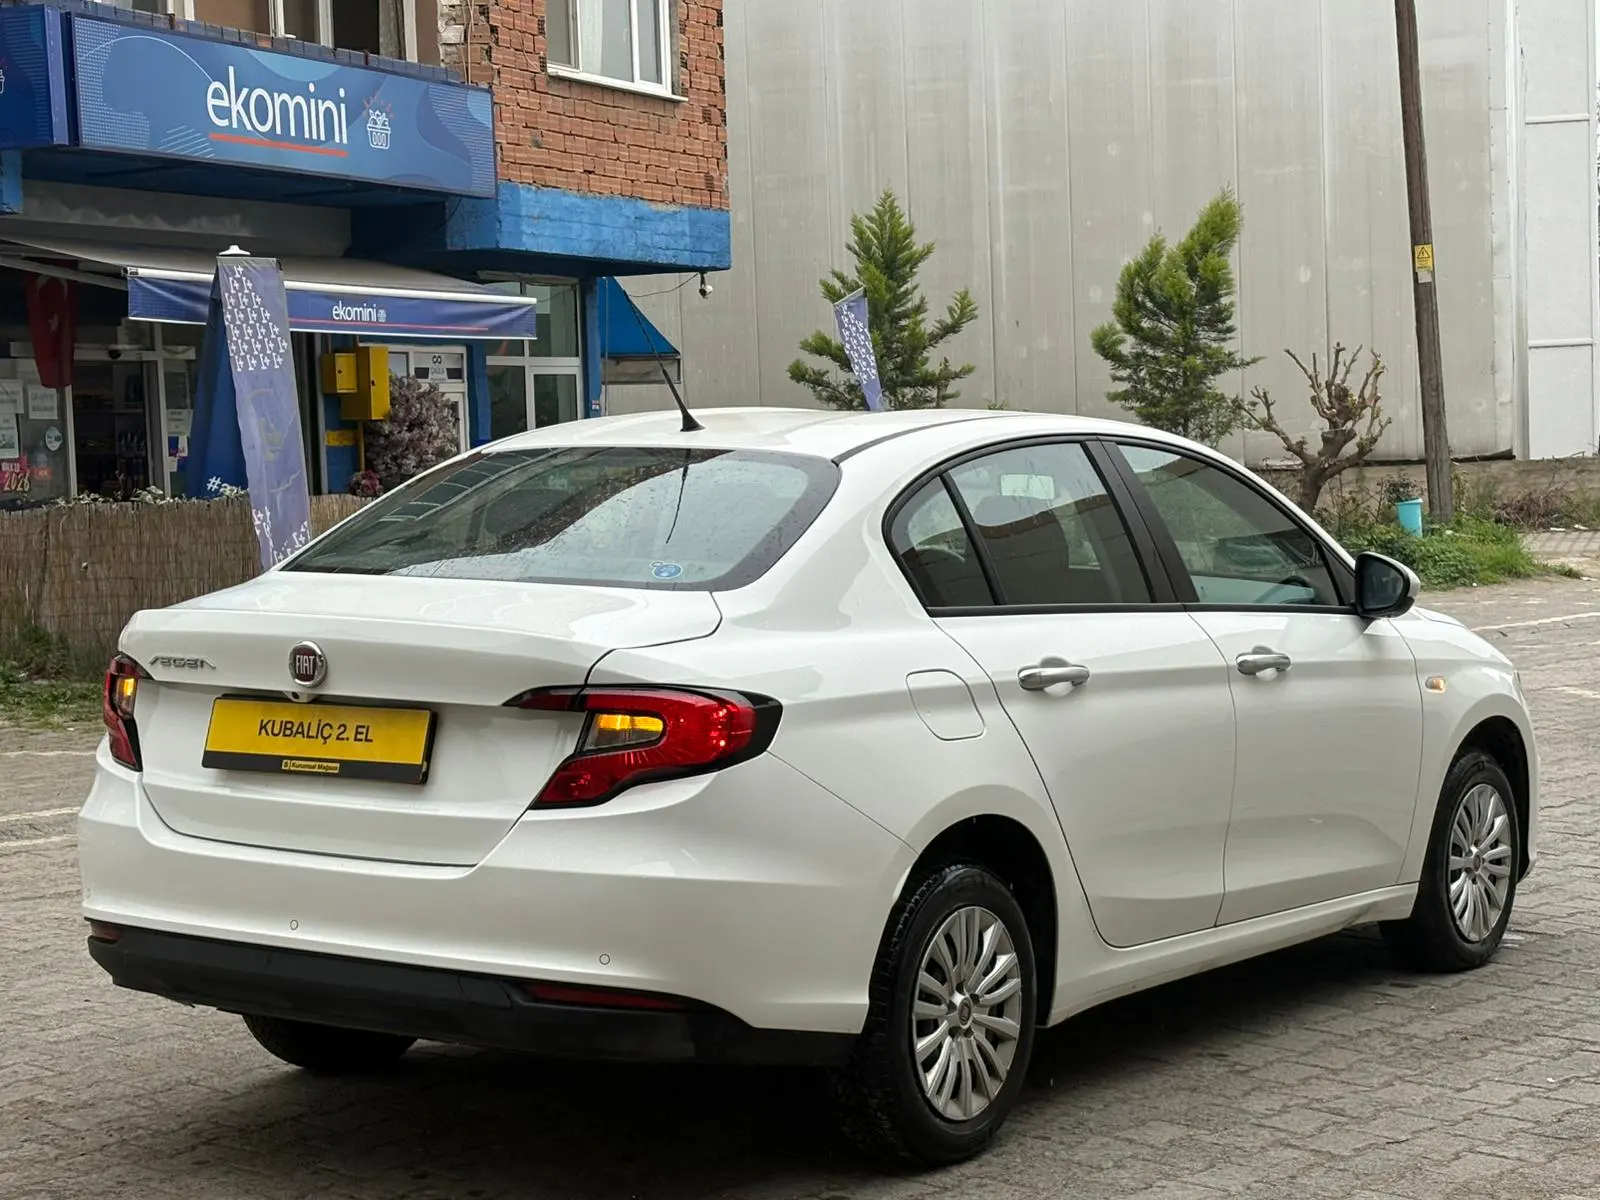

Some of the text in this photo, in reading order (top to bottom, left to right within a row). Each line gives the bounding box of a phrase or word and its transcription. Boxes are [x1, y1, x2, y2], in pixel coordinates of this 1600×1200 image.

[206, 65, 348, 145] ekomini
[332, 299, 377, 322] ekomini
[295, 654, 316, 676] FIAT
[257, 718, 375, 746] KUBALİÇ 2. EL
